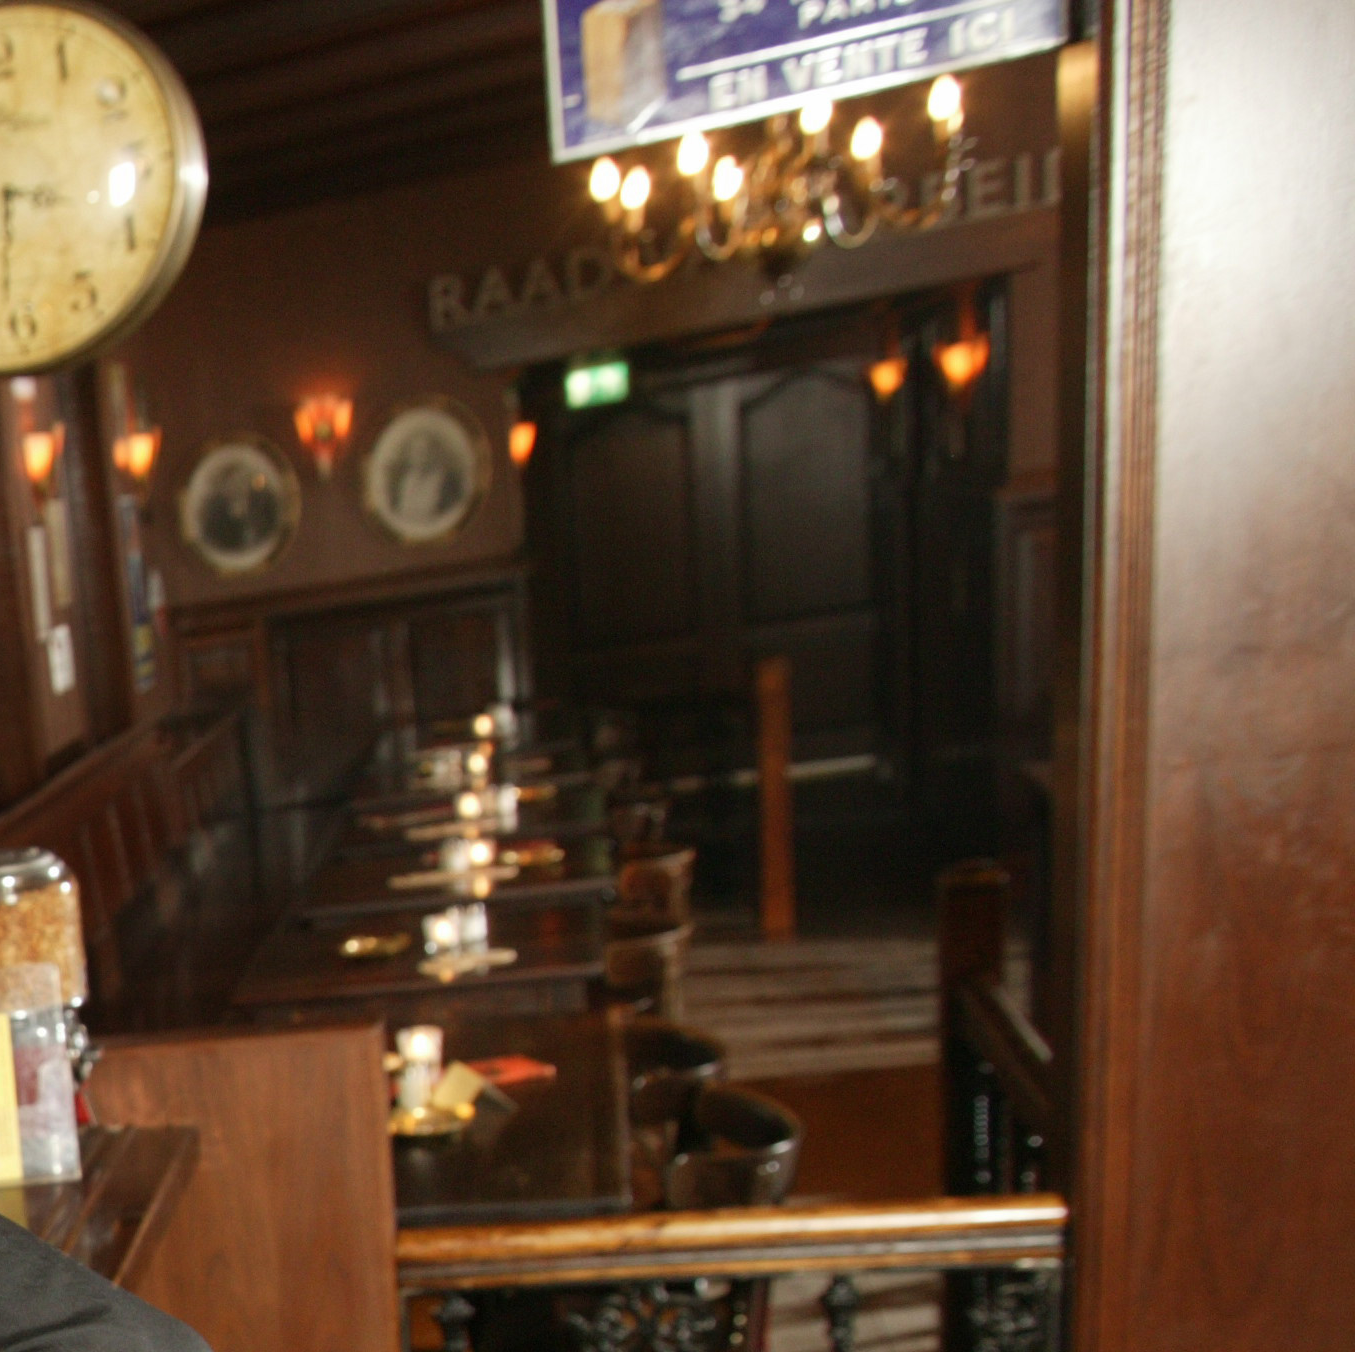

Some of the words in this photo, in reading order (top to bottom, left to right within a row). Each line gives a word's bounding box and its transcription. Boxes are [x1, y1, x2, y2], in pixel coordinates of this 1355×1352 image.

[708, 64, 768, 113] EN
[782, 27, 929, 92] VENTE
[948, 6, 1016, 57] ICI
